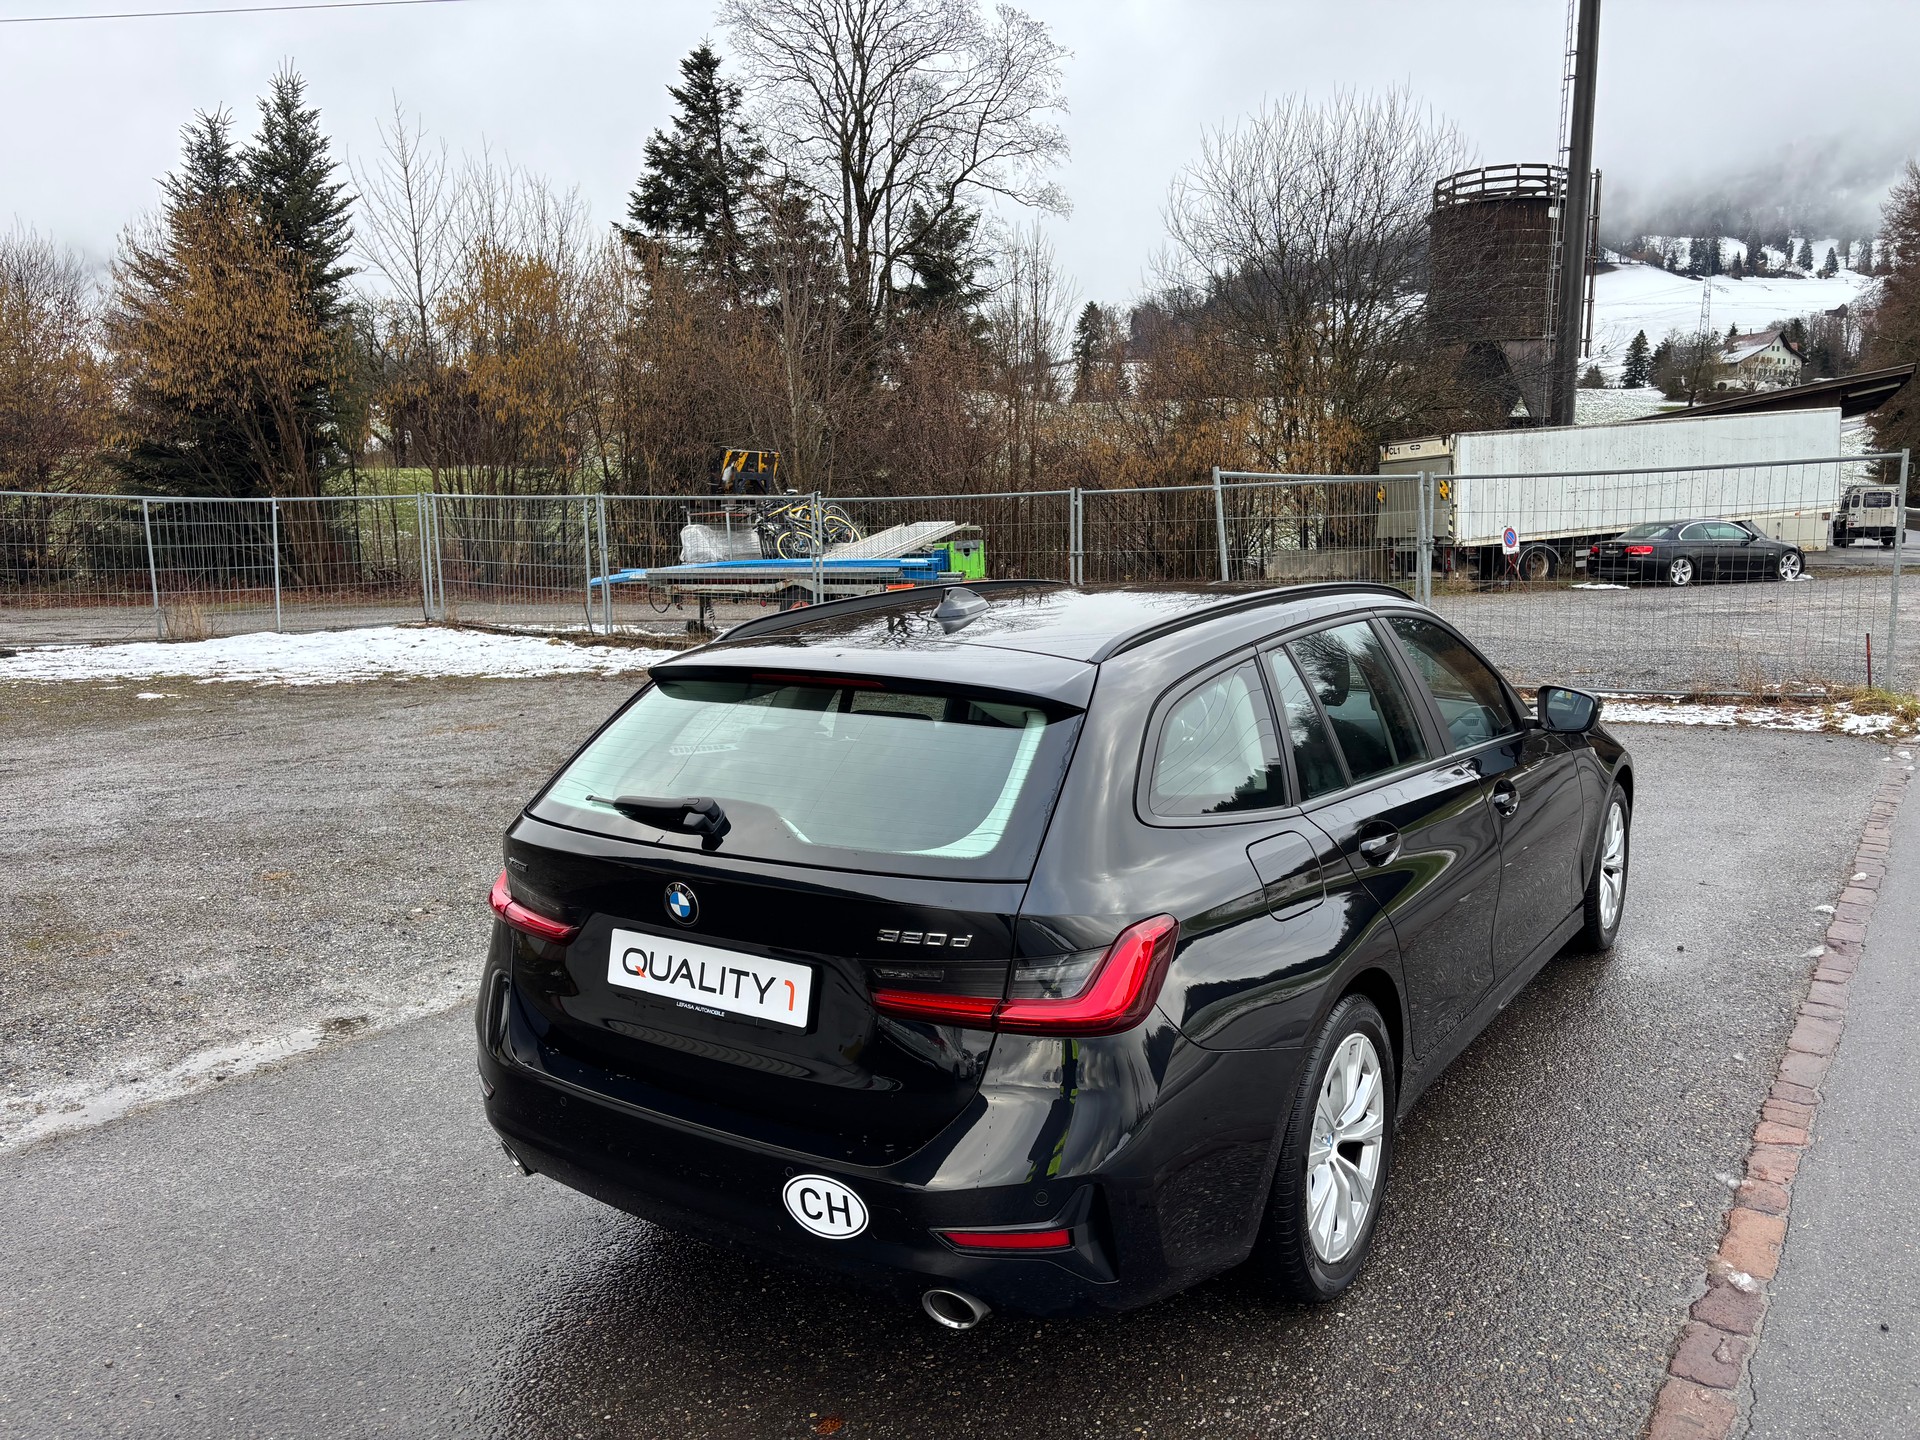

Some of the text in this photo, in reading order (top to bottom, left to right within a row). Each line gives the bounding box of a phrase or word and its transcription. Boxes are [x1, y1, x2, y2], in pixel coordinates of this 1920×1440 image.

[622, 946, 795, 1012] QUALITY 1
[694, 1005, 726, 1017] AUTOMOBILE
[799, 1187, 852, 1228] CH
